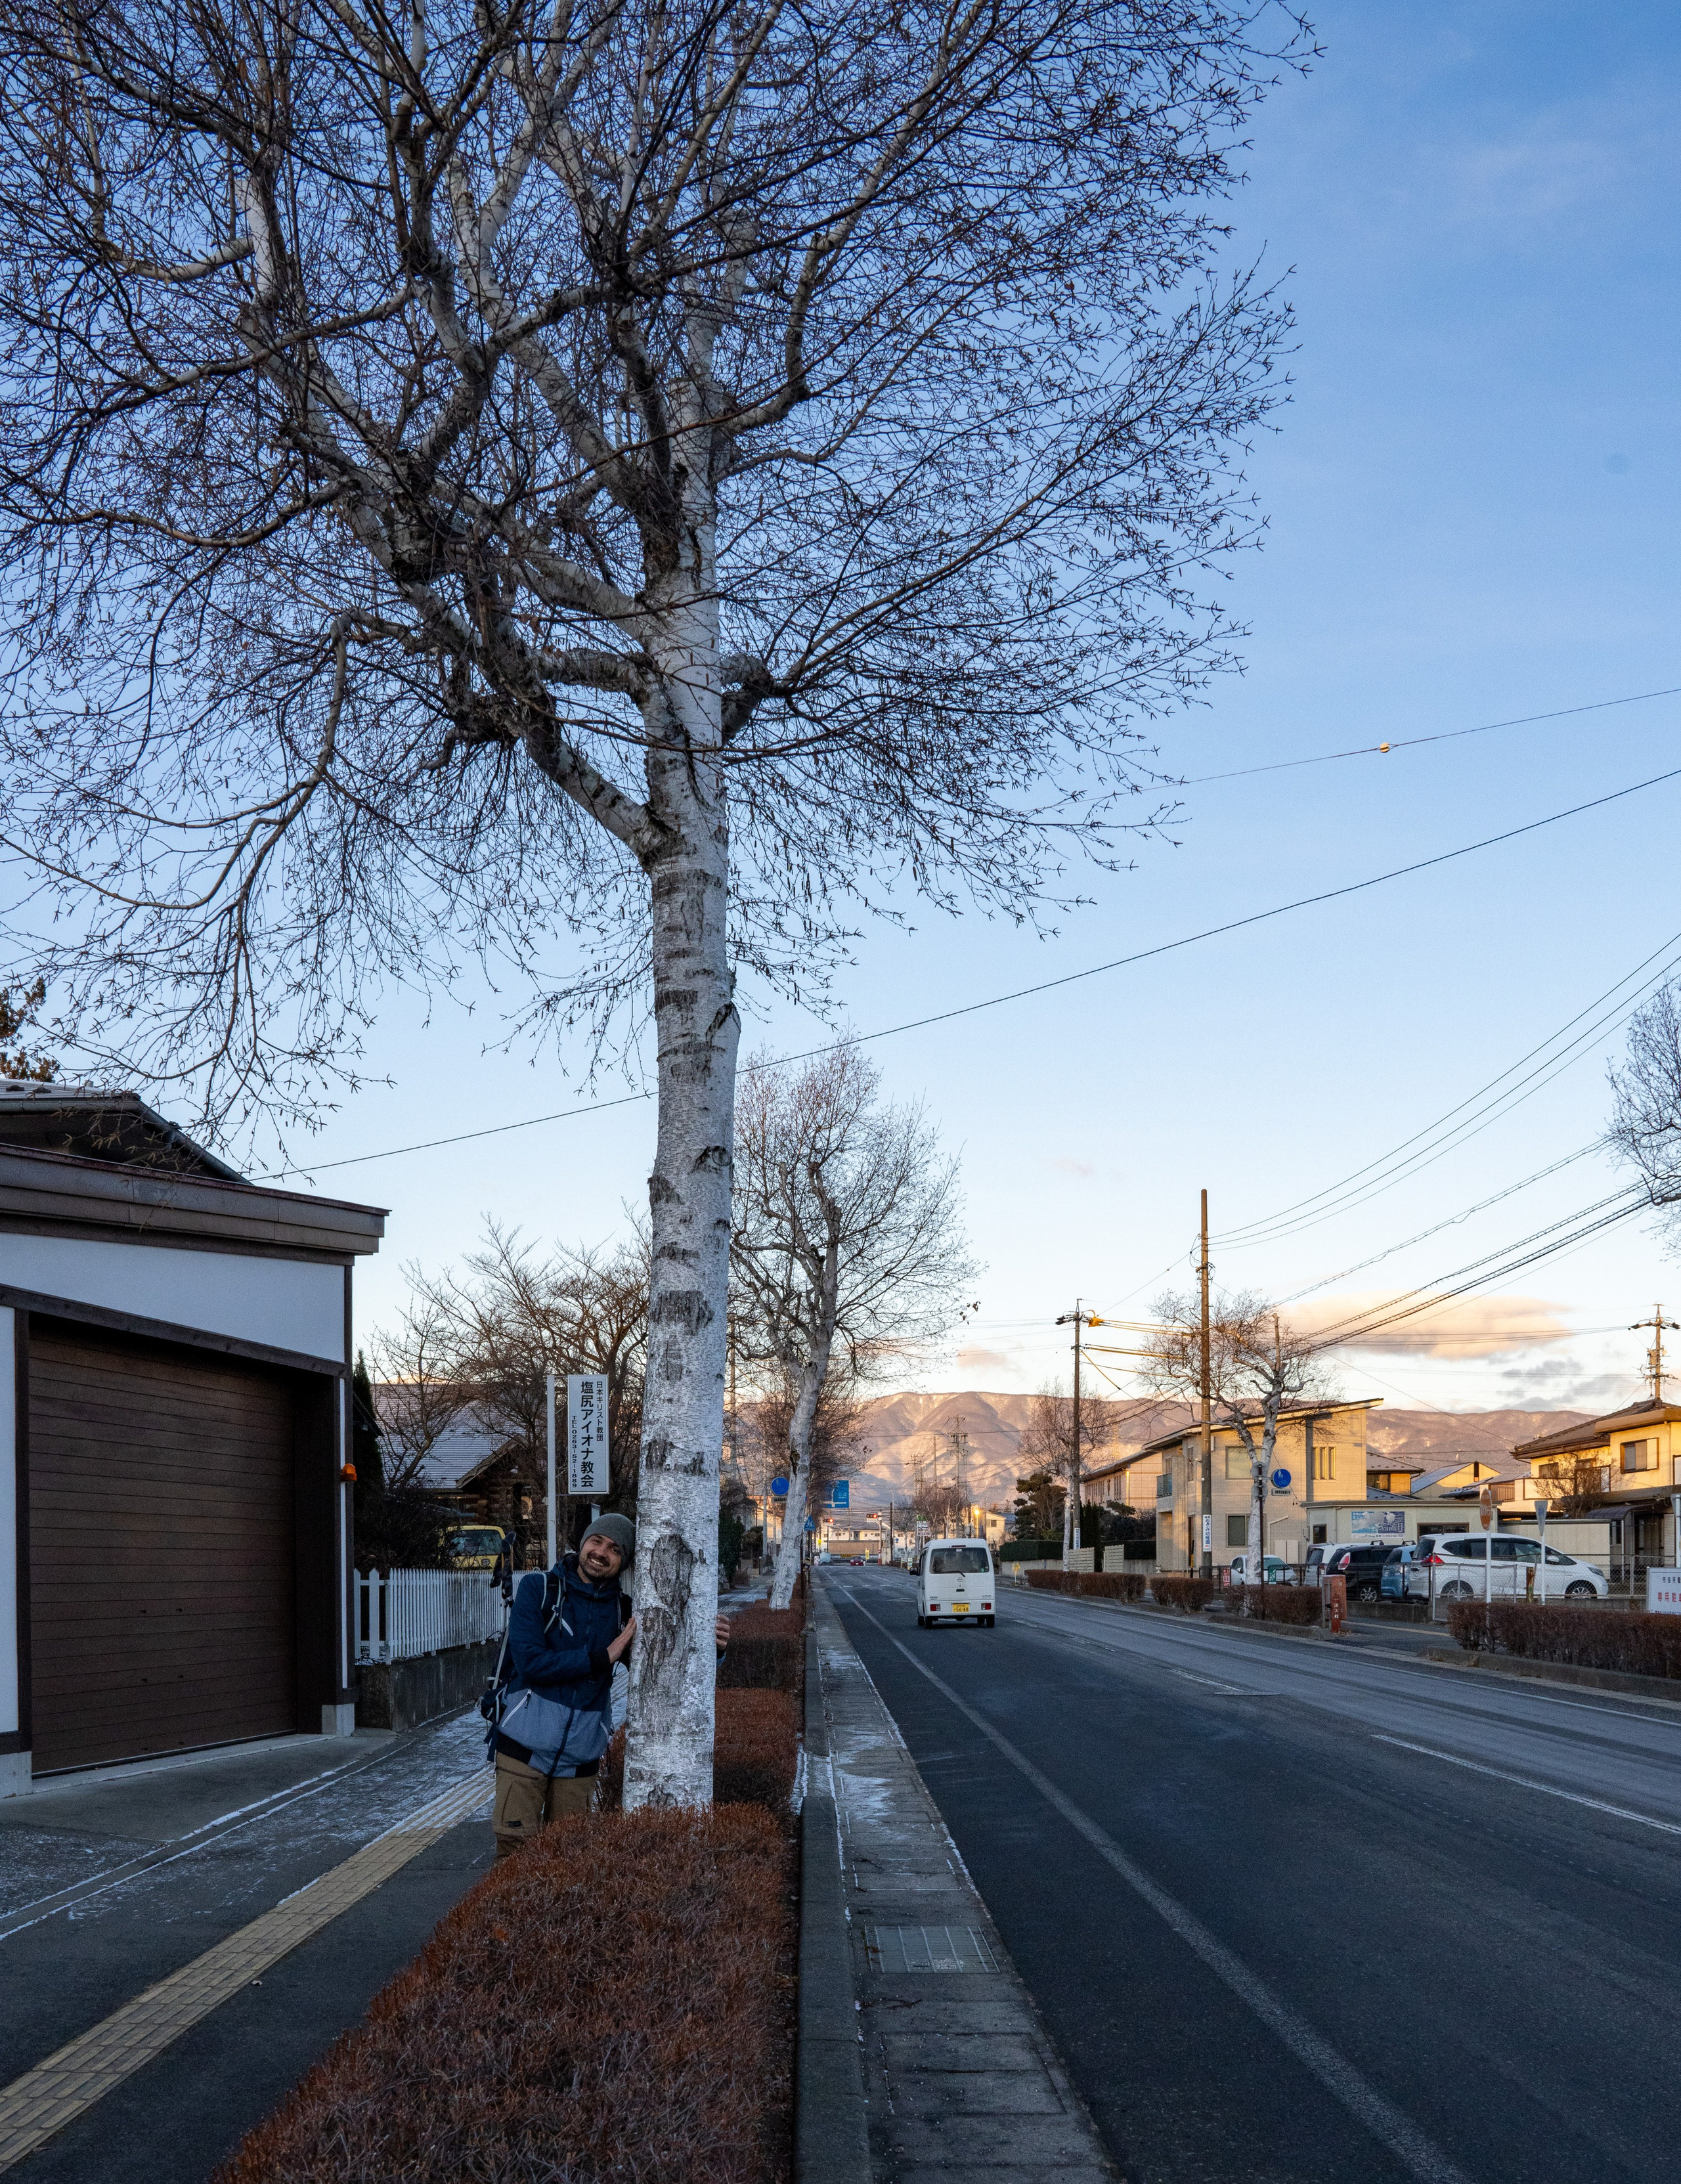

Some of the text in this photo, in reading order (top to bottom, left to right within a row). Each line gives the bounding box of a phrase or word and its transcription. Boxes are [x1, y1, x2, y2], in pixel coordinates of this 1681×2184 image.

[580, 1381, 594, 1488] 塩尻アイオナ教会
